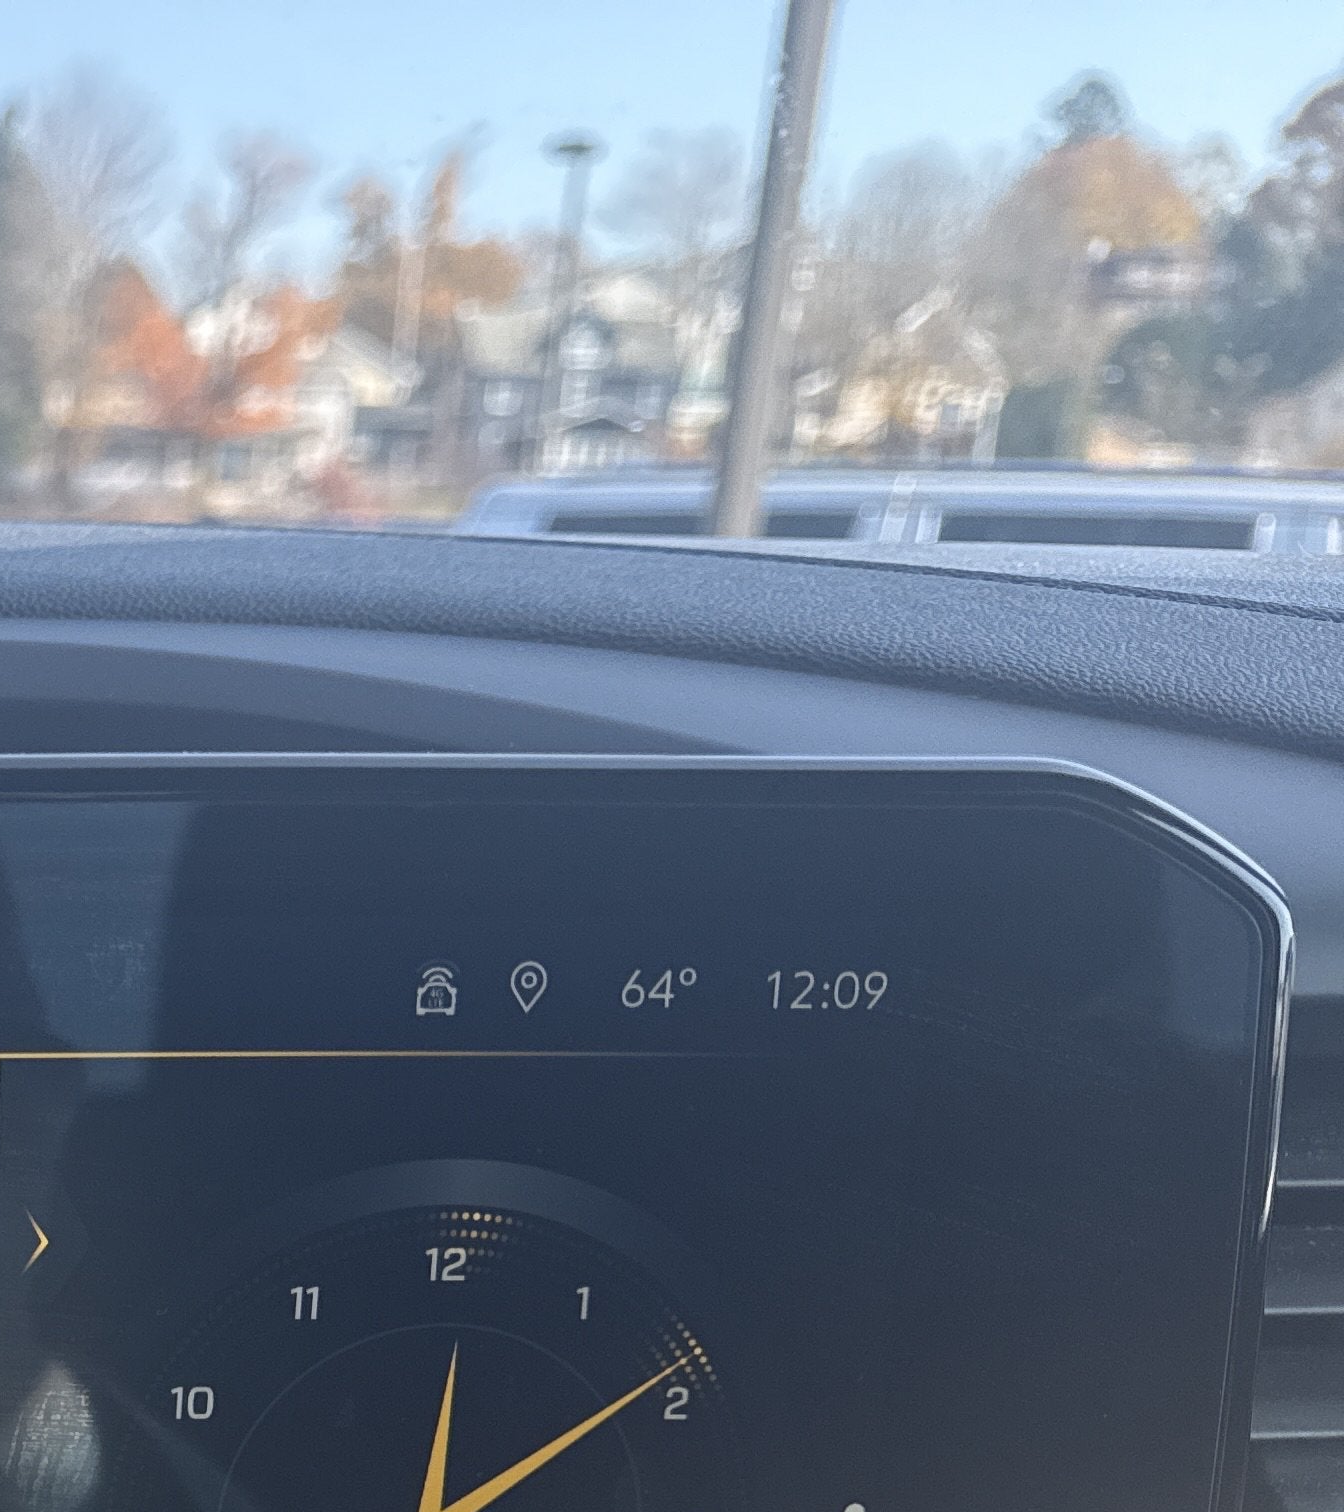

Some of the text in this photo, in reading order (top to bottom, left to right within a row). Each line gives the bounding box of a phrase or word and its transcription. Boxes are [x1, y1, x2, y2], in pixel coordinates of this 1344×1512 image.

[767, 970, 888, 1010] 12:09
[425, 1247, 467, 1282] 12
[290, 1286, 320, 1320] 11
[576, 1286, 590, 1320] 1
[170, 1386, 215, 1420] 10
[663, 1386, 689, 1420] 2
